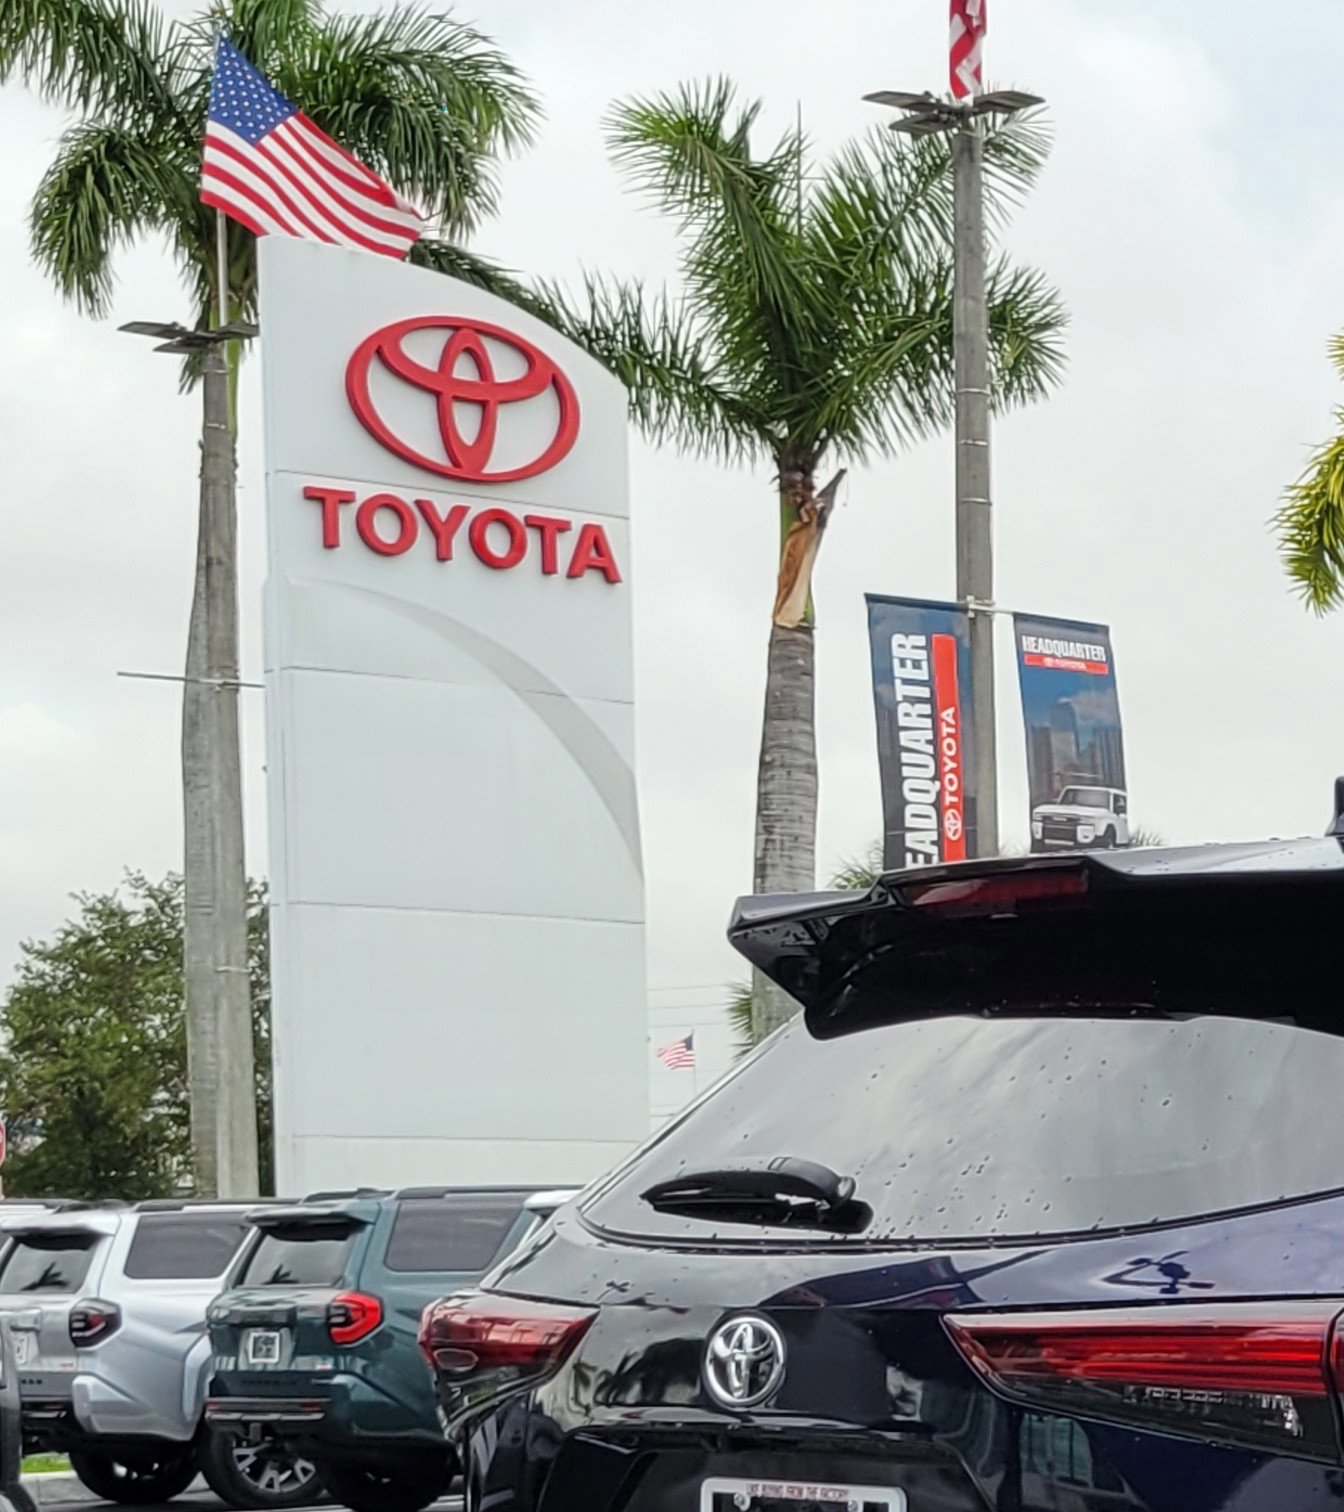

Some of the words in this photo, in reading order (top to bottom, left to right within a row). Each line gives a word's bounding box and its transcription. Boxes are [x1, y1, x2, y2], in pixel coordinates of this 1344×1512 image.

[303, 486, 622, 584] TOYOTA
[1022, 635, 1106, 662] HEADQUARTER
[891, 633, 940, 868] EADQUARTER
[940, 706, 960, 806] TOYOTA
